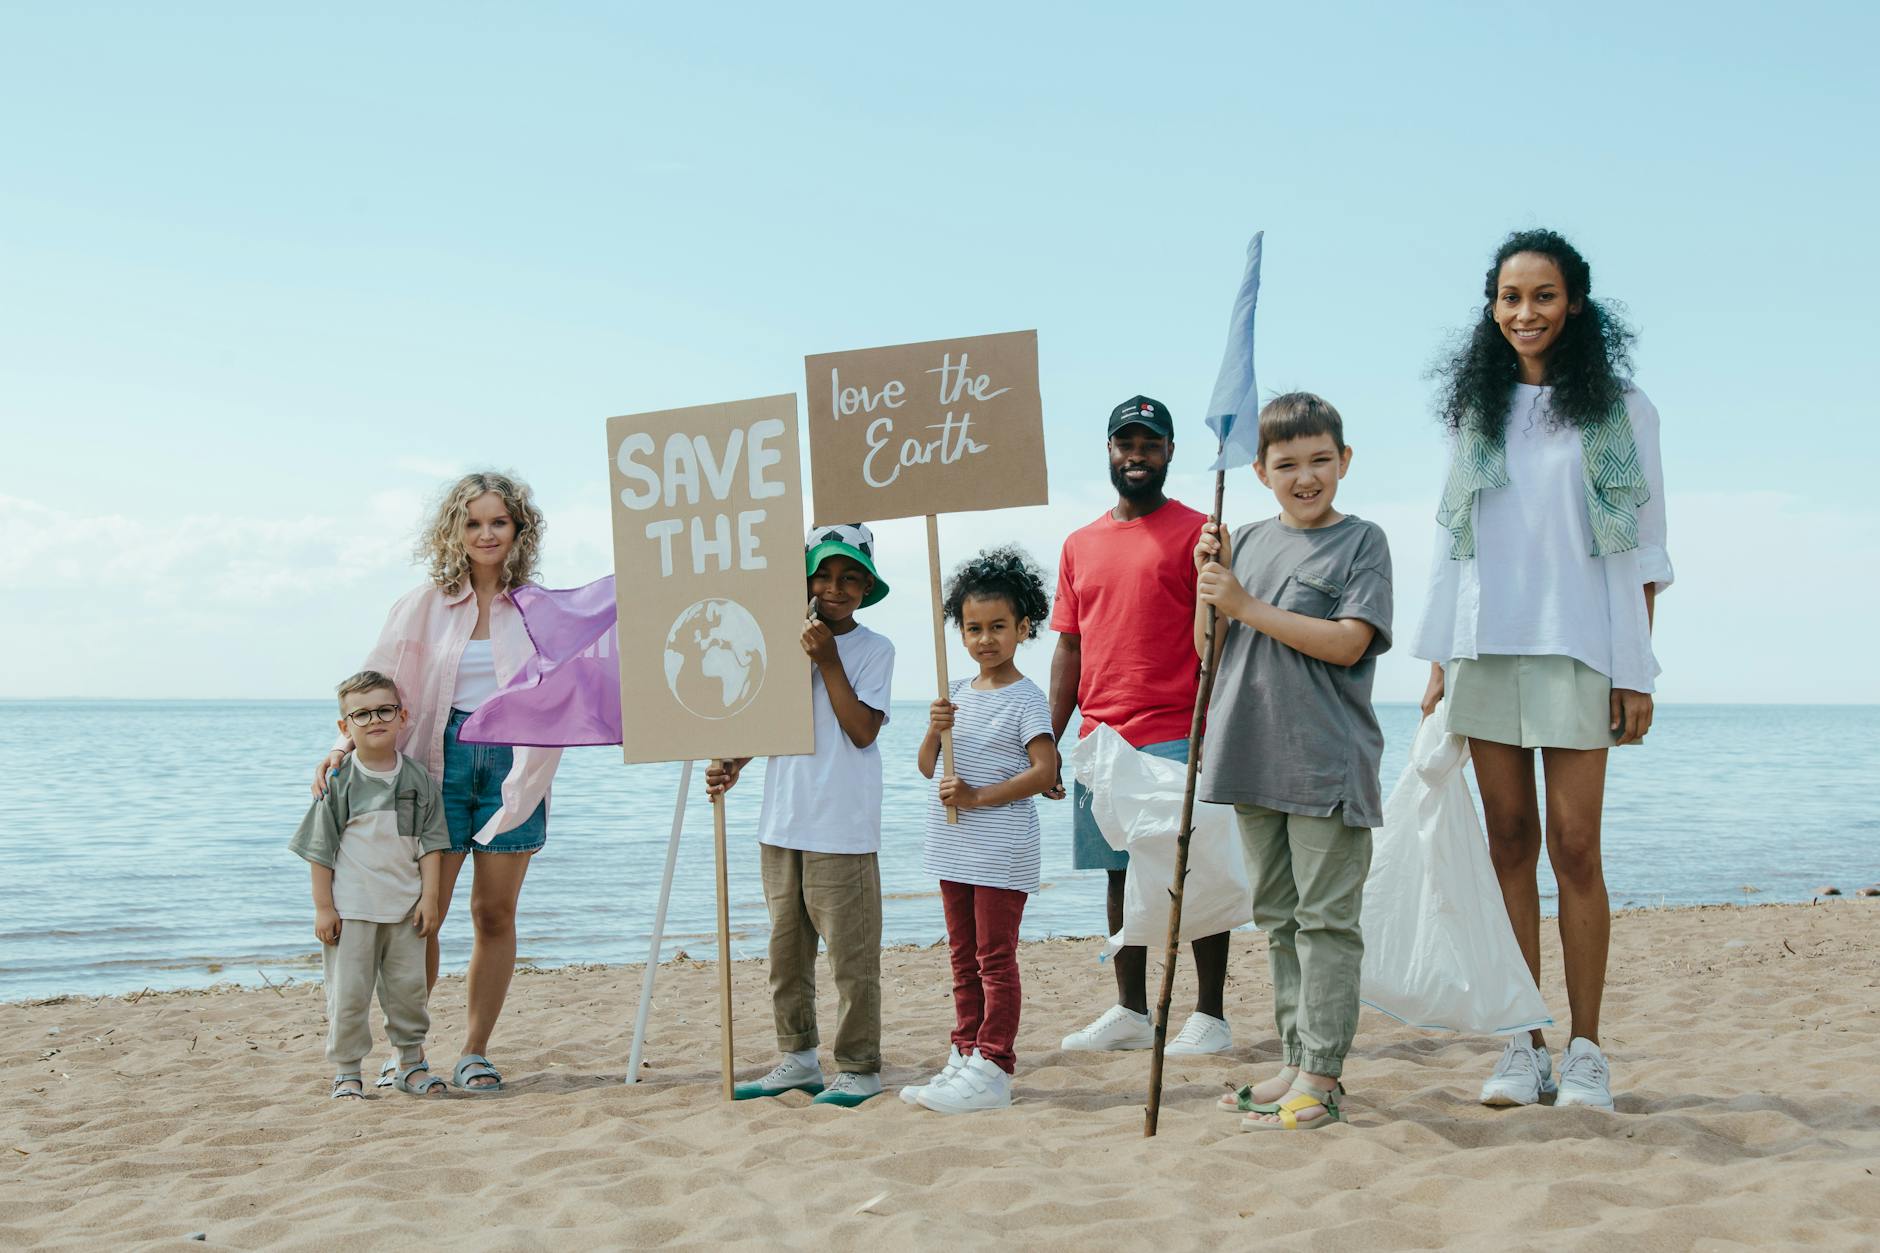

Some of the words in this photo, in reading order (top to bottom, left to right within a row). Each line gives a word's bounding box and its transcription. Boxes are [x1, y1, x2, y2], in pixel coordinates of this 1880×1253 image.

[831, 367, 905, 420] love
[925, 352, 1013, 405] the
[616, 417, 786, 511] SAVE
[862, 411, 989, 489] Earth
[645, 509, 768, 577] THE
